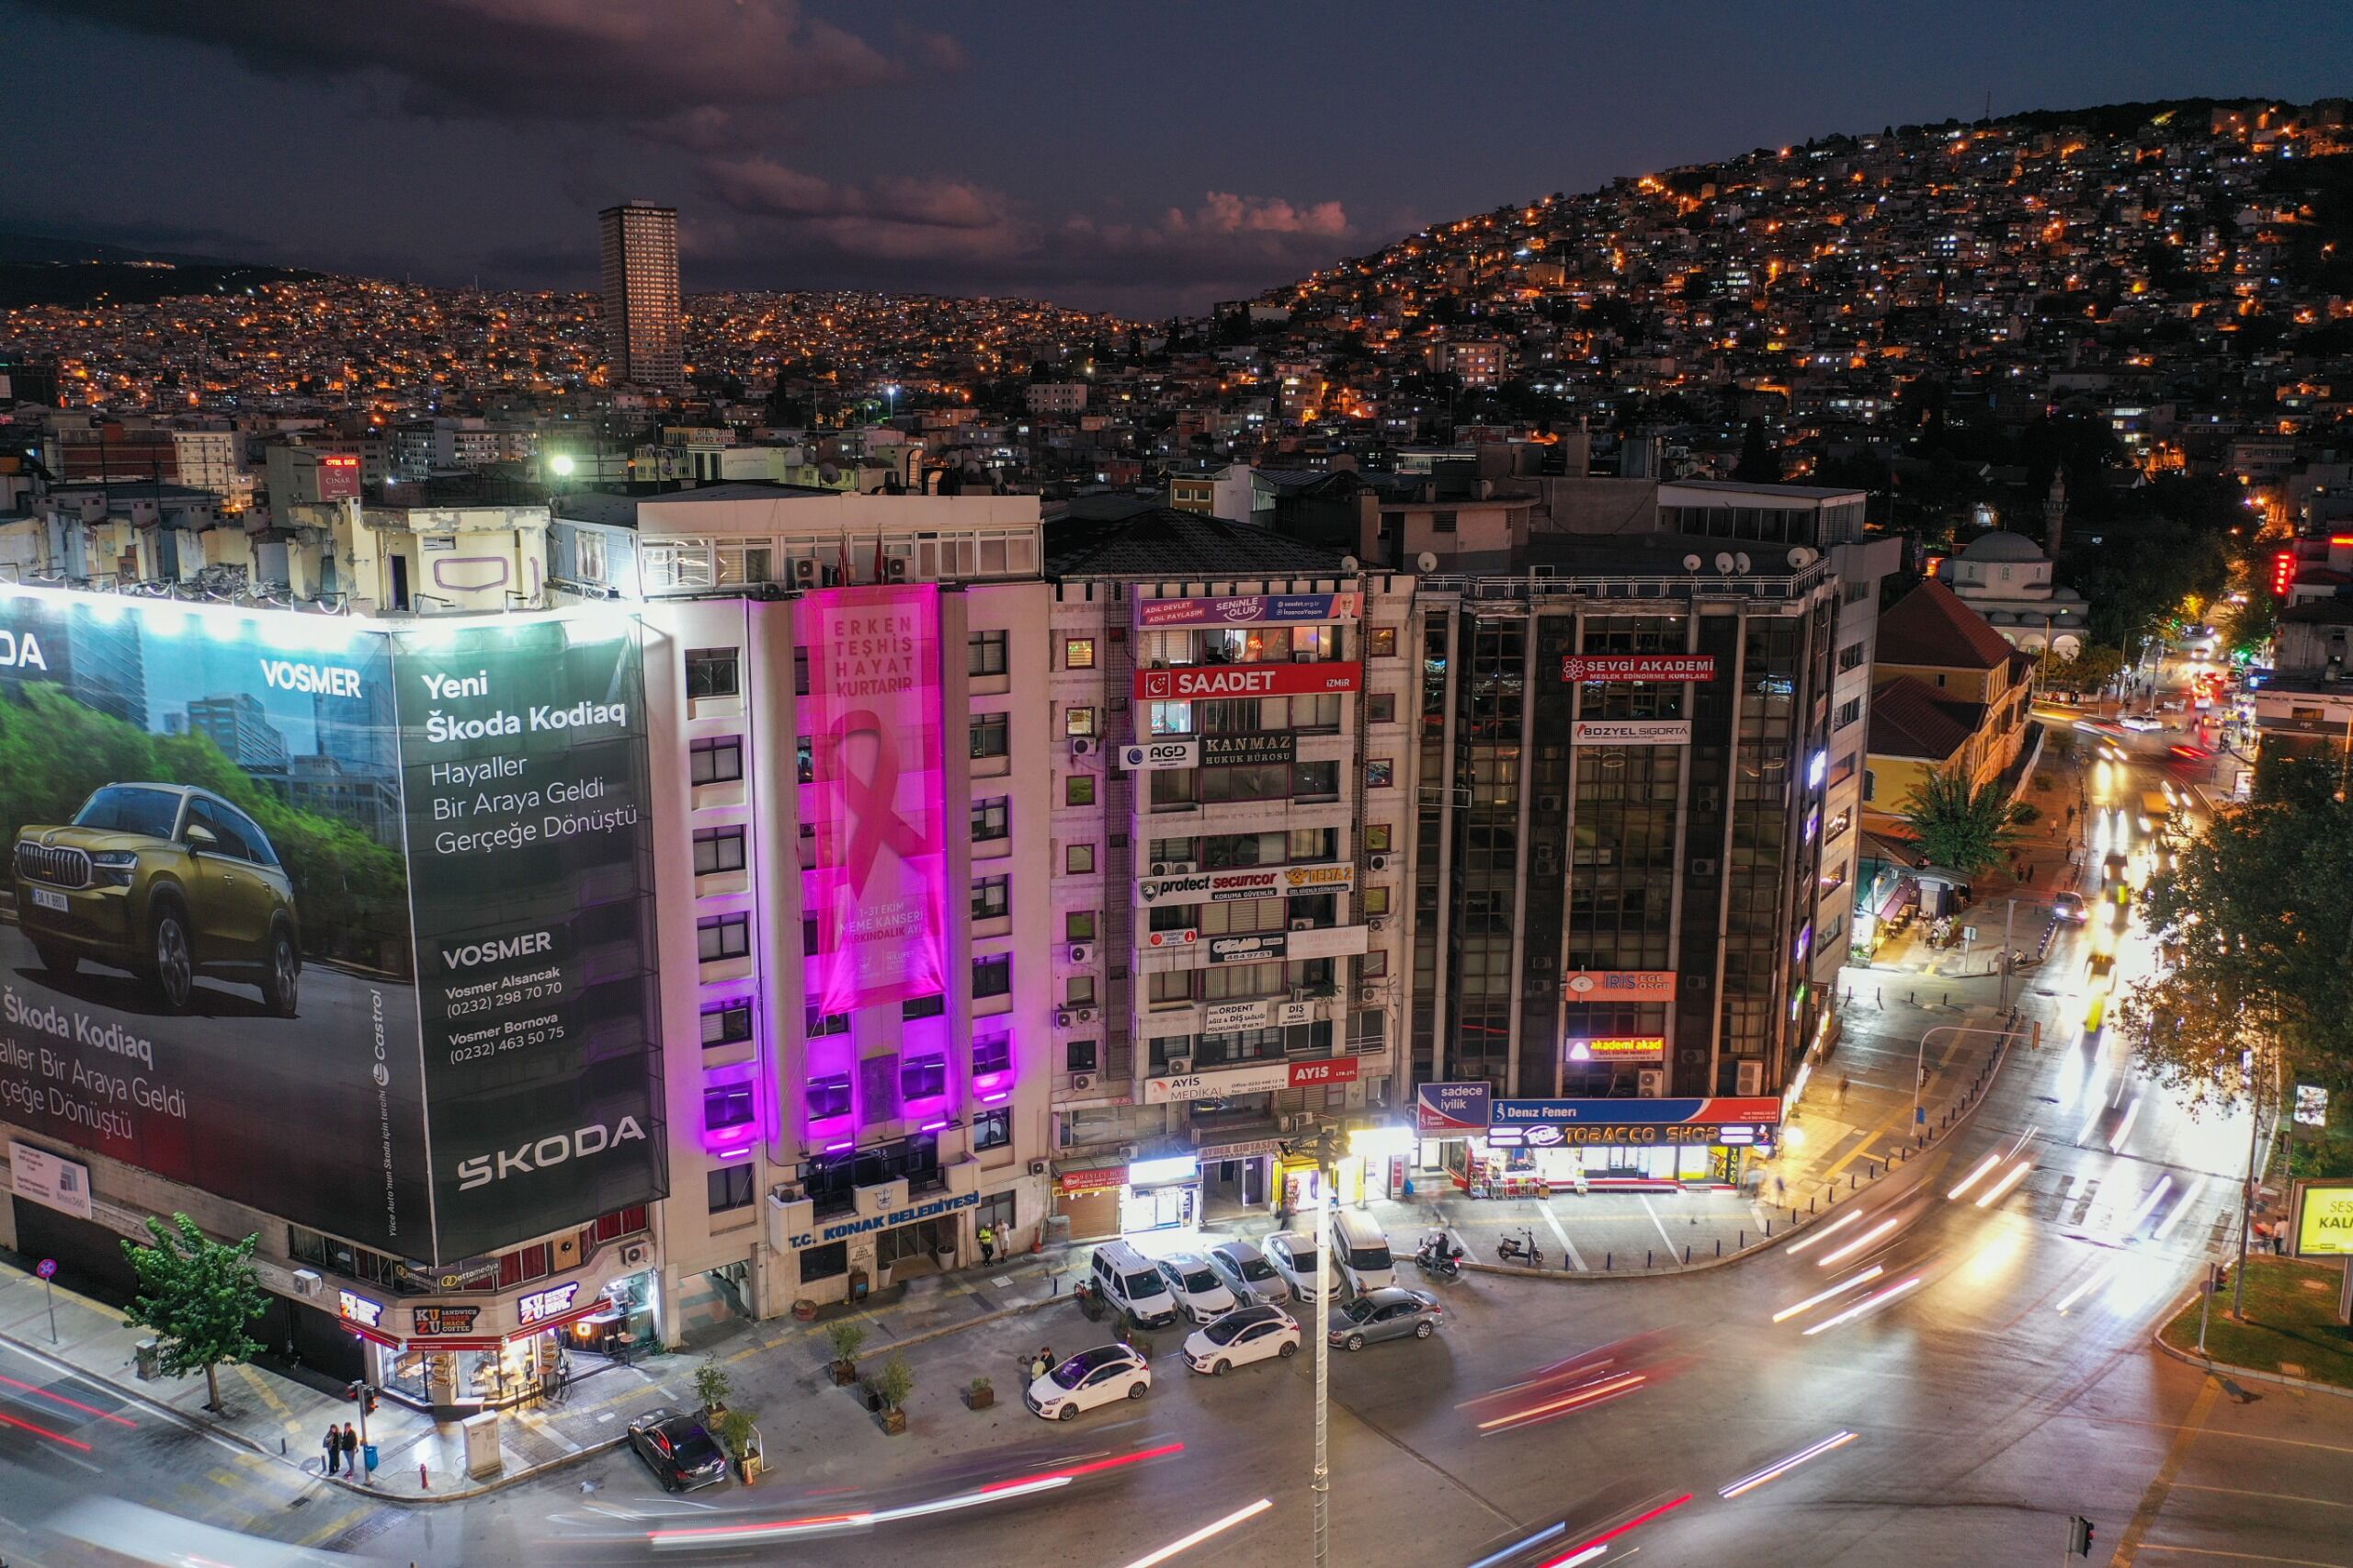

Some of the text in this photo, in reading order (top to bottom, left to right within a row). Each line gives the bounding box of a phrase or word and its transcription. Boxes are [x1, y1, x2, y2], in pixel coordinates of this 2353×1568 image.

[1164, 601, 1190, 611] DEVLET
[1229, 606, 1256, 617] OLUR
[834, 617, 911, 636] ERKEN
[835, 633, 913, 657] TEŞHİS
[835, 657, 913, 677] HAYAT
[1586, 658, 1713, 672] SEVGİ AKADEMİ
[260, 658, 362, 699] VOSMER
[421, 669, 488, 699] Yeni
[836, 676, 913, 698] KURTARIR
[1178, 671, 1277, 695] SAADET
[426, 700, 627, 743] Škoda Kodiaq
[1585, 727, 1688, 735] BOZYEL SİGORTA
[1150, 745, 1187, 758] AGD
[1206, 736, 1291, 753] KANMAZ
[1206, 752, 1290, 765] HUKUK BÜROSU
[431, 756, 528, 787] Hayaller
[433, 777, 604, 821] Bir Araya Geldi
[435, 803, 637, 855] Gerçeğe Dönüştü
[1160, 871, 1278, 896] protect securicor
[1309, 868, 1353, 883] DELTA 2
[1214, 889, 1275, 901] KORUMA GÜVENLİK
[881, 901, 904, 915] EKİM
[839, 910, 924, 935] MEME KANSERİ
[442, 932, 551, 970] VOSMER
[446, 966, 561, 1000] Vosmer Alsancak
[447, 982, 563, 1019] (0232) 298 70 70
[1219, 1004, 1254, 1015] ORDENT
[1289, 1004, 1304, 1014] DİŞ
[4, 985, 154, 1071] Škoda Kodiaq
[369, 989, 386, 1061] Castrol
[1230, 1014, 1244, 1023] DİŞ
[449, 1014, 558, 1046] Vosmer Bornova
[450, 1026, 564, 1065] (0232) 463 50 75
[1589, 1039, 1663, 1051] akademi akad
[40, 1048, 66, 1083] Bir
[72, 1058, 127, 1104] Araya
[132, 1077, 187, 1119] Geldi
[1171, 1076, 1200, 1088] AYİS
[1295, 1066, 1329, 1081] AYİS
[1171, 1087, 1223, 1101] MEDİKAL
[1440, 1085, 1483, 1096] sadece
[1440, 1099, 1467, 1111] iyilik
[49, 1090, 133, 1141] Dönüştü
[1564, 1127, 1655, 1144] TOBACCO
[1666, 1127, 1720, 1143] SHOP
[458, 1115, 646, 1191] SKODA
[790, 1190, 980, 1248] T.C. KONAK BELEDİYESİ
[457, 1263, 499, 1281] ottomedya
